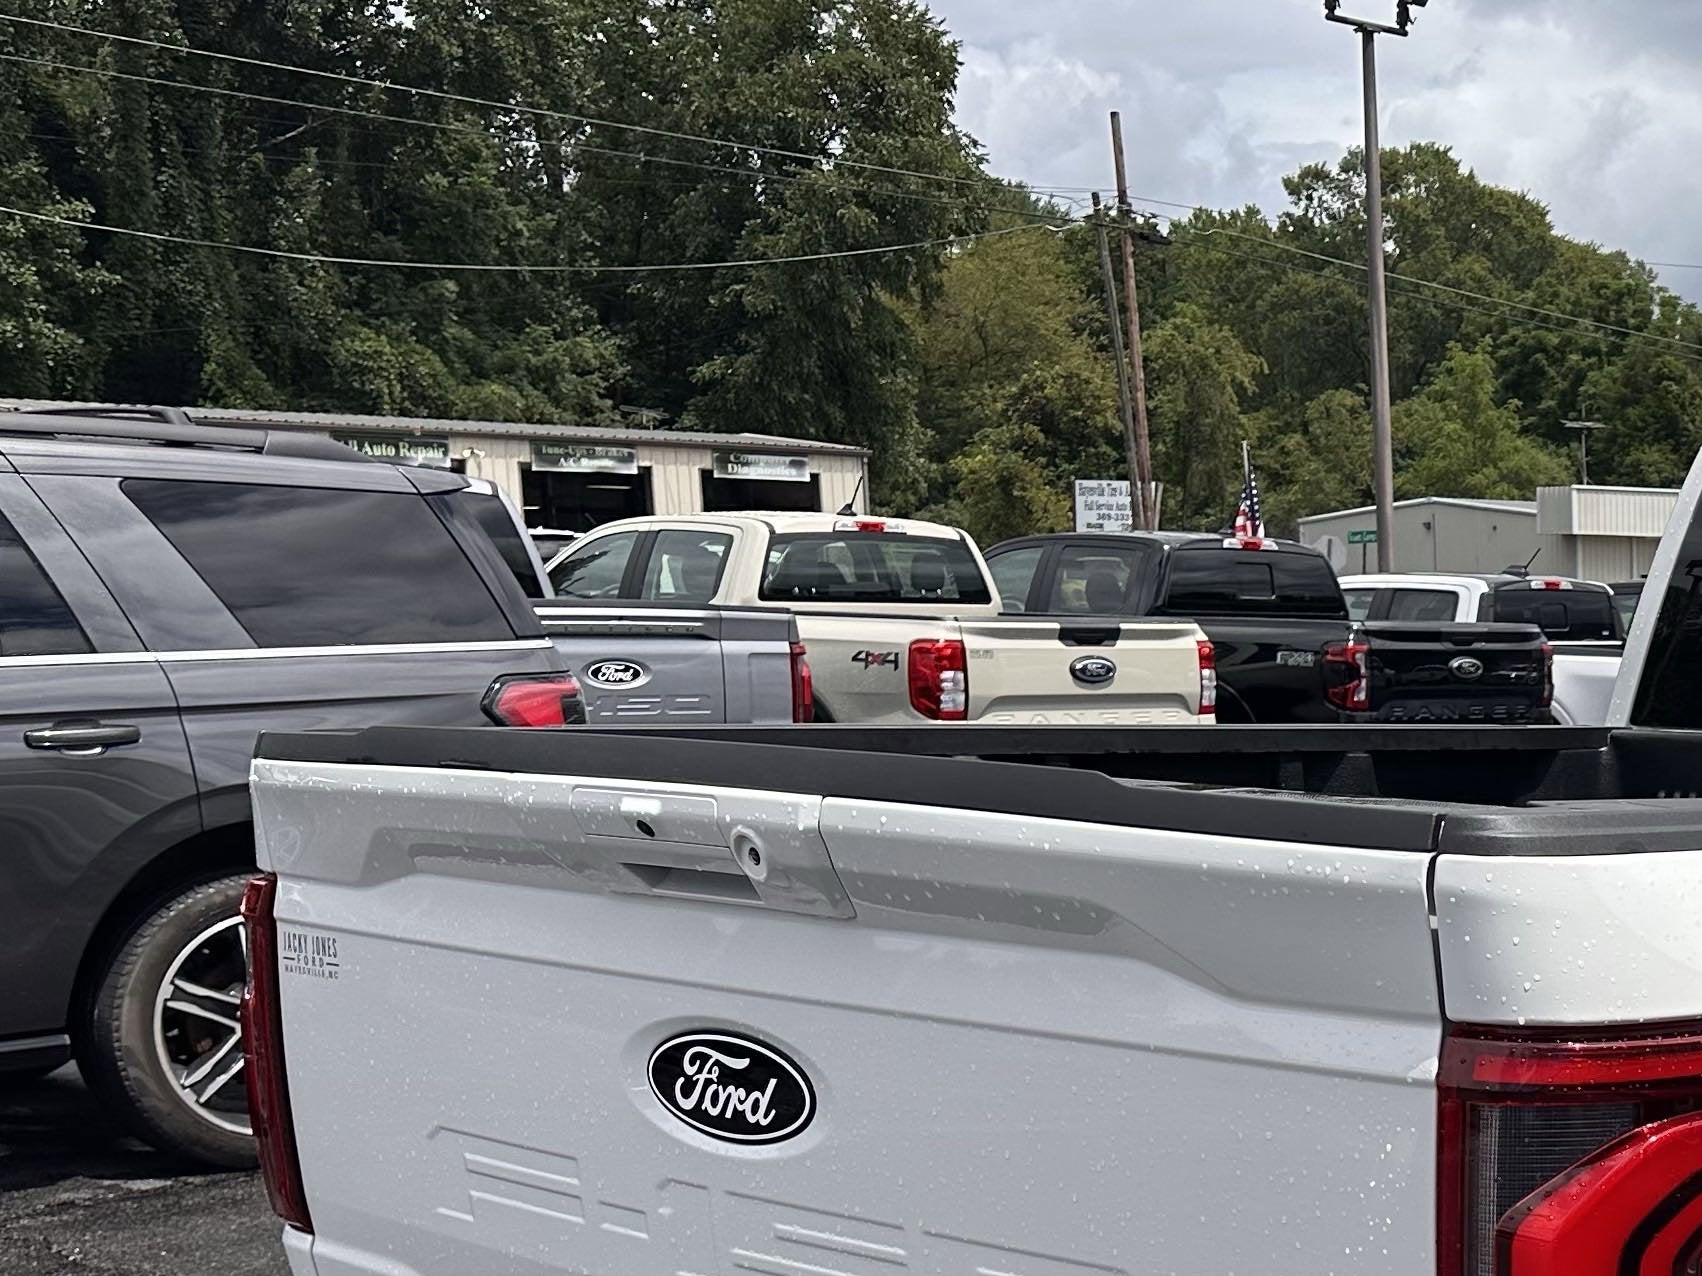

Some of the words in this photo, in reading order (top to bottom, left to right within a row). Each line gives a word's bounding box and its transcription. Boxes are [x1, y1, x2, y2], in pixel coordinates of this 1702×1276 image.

[361, 441, 396, 457] Auto
[398, 442, 446, 462] Repair
[597, 663, 635, 682] Ford
[1390, 706, 1532, 721] RANGER
[283, 931, 309, 954] JACKY
[311, 935, 338, 959] JONES
[296, 954, 325, 968] FORD
[675, 1044, 777, 1128] Ford
